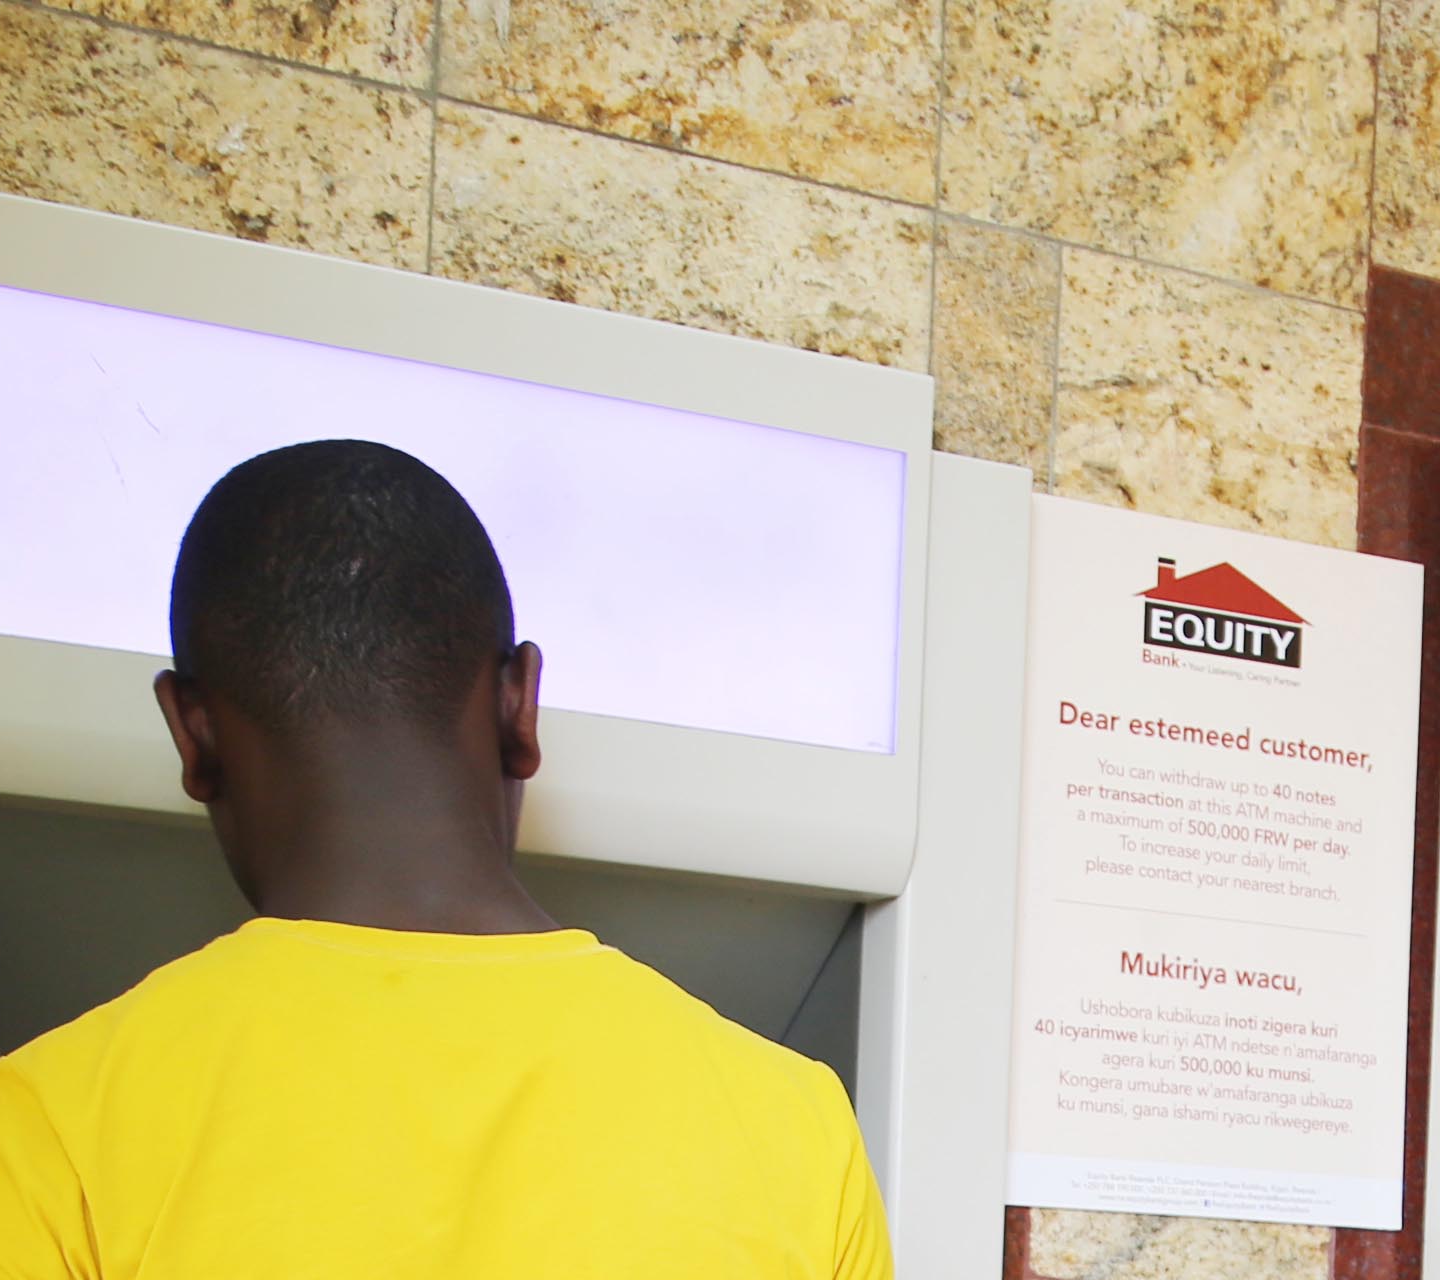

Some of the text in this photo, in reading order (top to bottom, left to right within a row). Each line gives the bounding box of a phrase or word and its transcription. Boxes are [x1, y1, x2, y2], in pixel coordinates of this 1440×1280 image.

[1150, 608, 1295, 660] EQUITY
[1142, 648, 1180, 669] Bank
[1059, 701, 1374, 772] Dear estemeed customer,
[1097, 758, 1336, 807] You can withdraw up to 40 notes
[1066, 782, 1362, 834] per transaction at this ATM machine and
[1077, 809, 1350, 857] a maximum of 500,000 FRW per day.
[1120, 834, 1311, 876] To increase your daily limit,
[1085, 856, 1340, 902] please contact your nearest branch.
[1120, 950, 1303, 995] Mukiriya wacu,
[1080, 998, 1339, 1038] Ushobora kubikuza inoti zigera kuri
[1034, 1019, 1377, 1068] 40 icyarimwe kuri iyi ATM ndetse n'amafaranga
[1102, 1052, 1315, 1083] agera kuri 500,000 ku munsi.
[1059, 1071, 1353, 1111] Kongera umubare w'amafaranga ubikuza
[1057, 1094, 1353, 1136] ku munsi, gana ishami ryacu rikwegereye.
